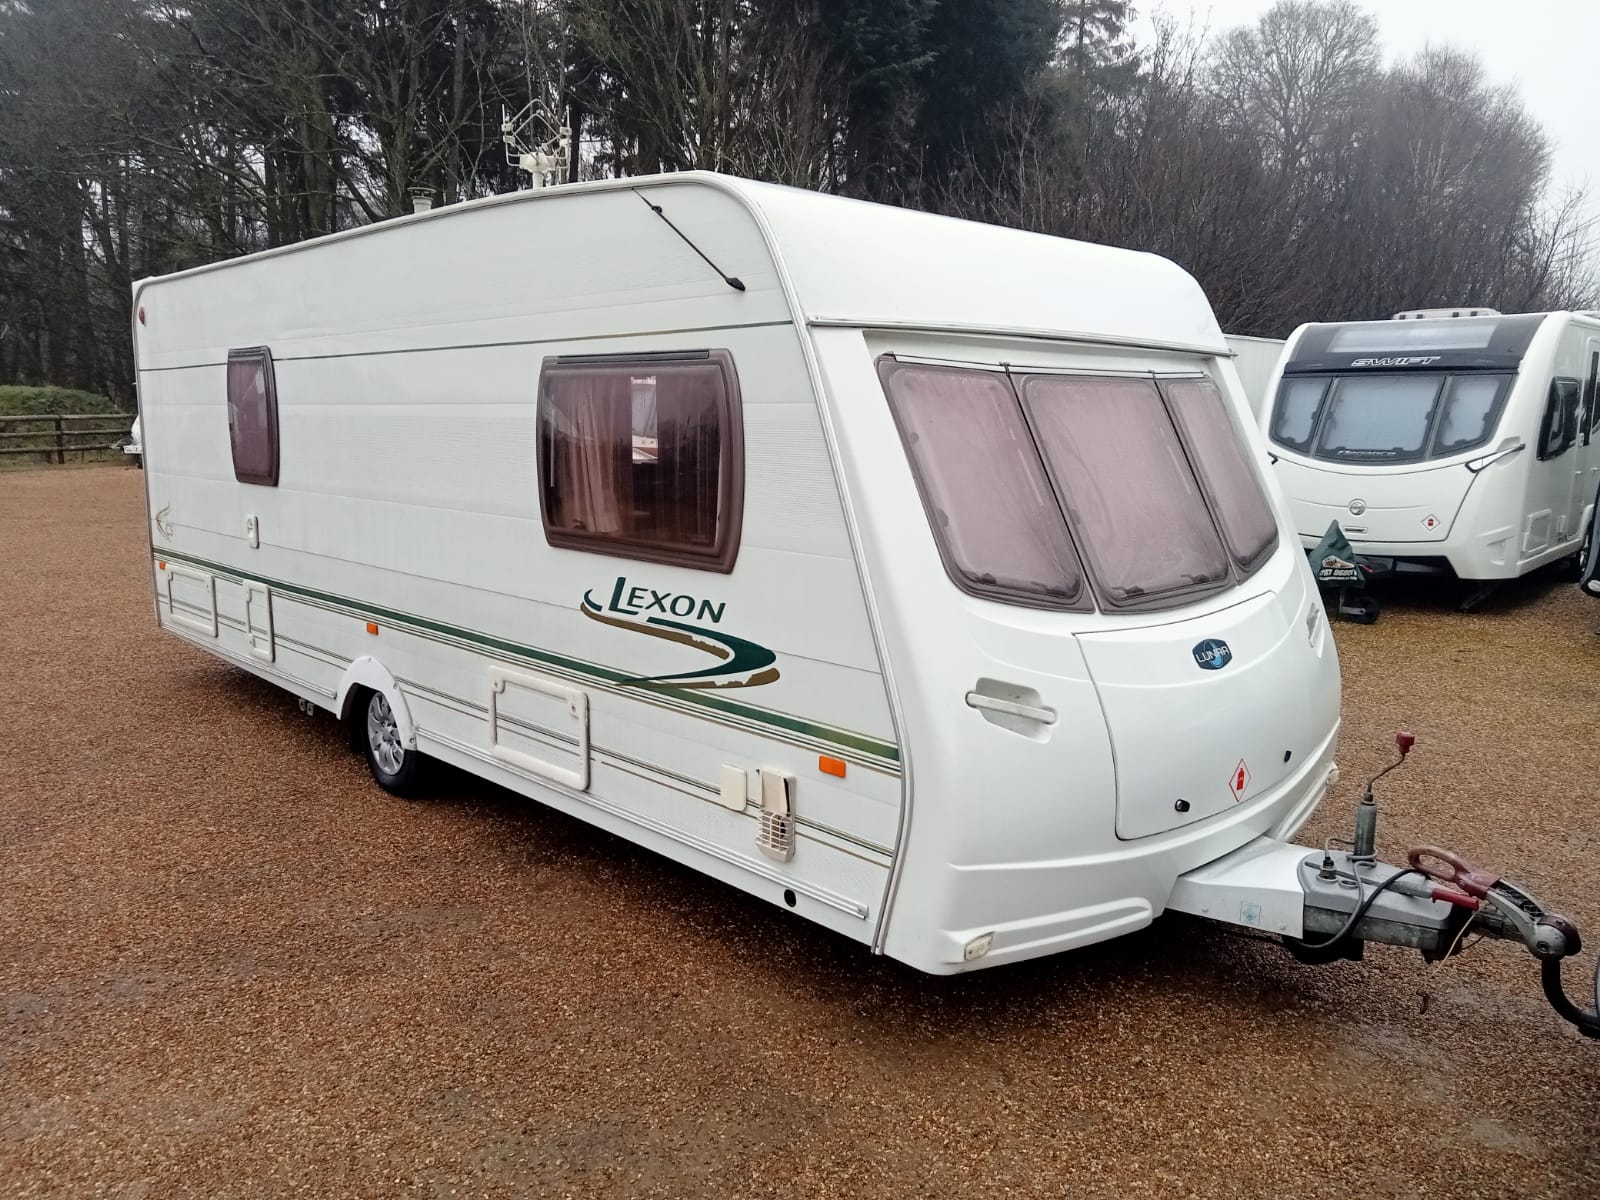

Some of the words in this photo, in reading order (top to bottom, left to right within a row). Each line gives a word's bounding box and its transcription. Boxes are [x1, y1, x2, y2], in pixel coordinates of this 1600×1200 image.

[1351, 356, 1441, 366] SWIFT
[608, 577, 726, 623] LEXON
[1195, 646, 1229, 662] LUNAR
